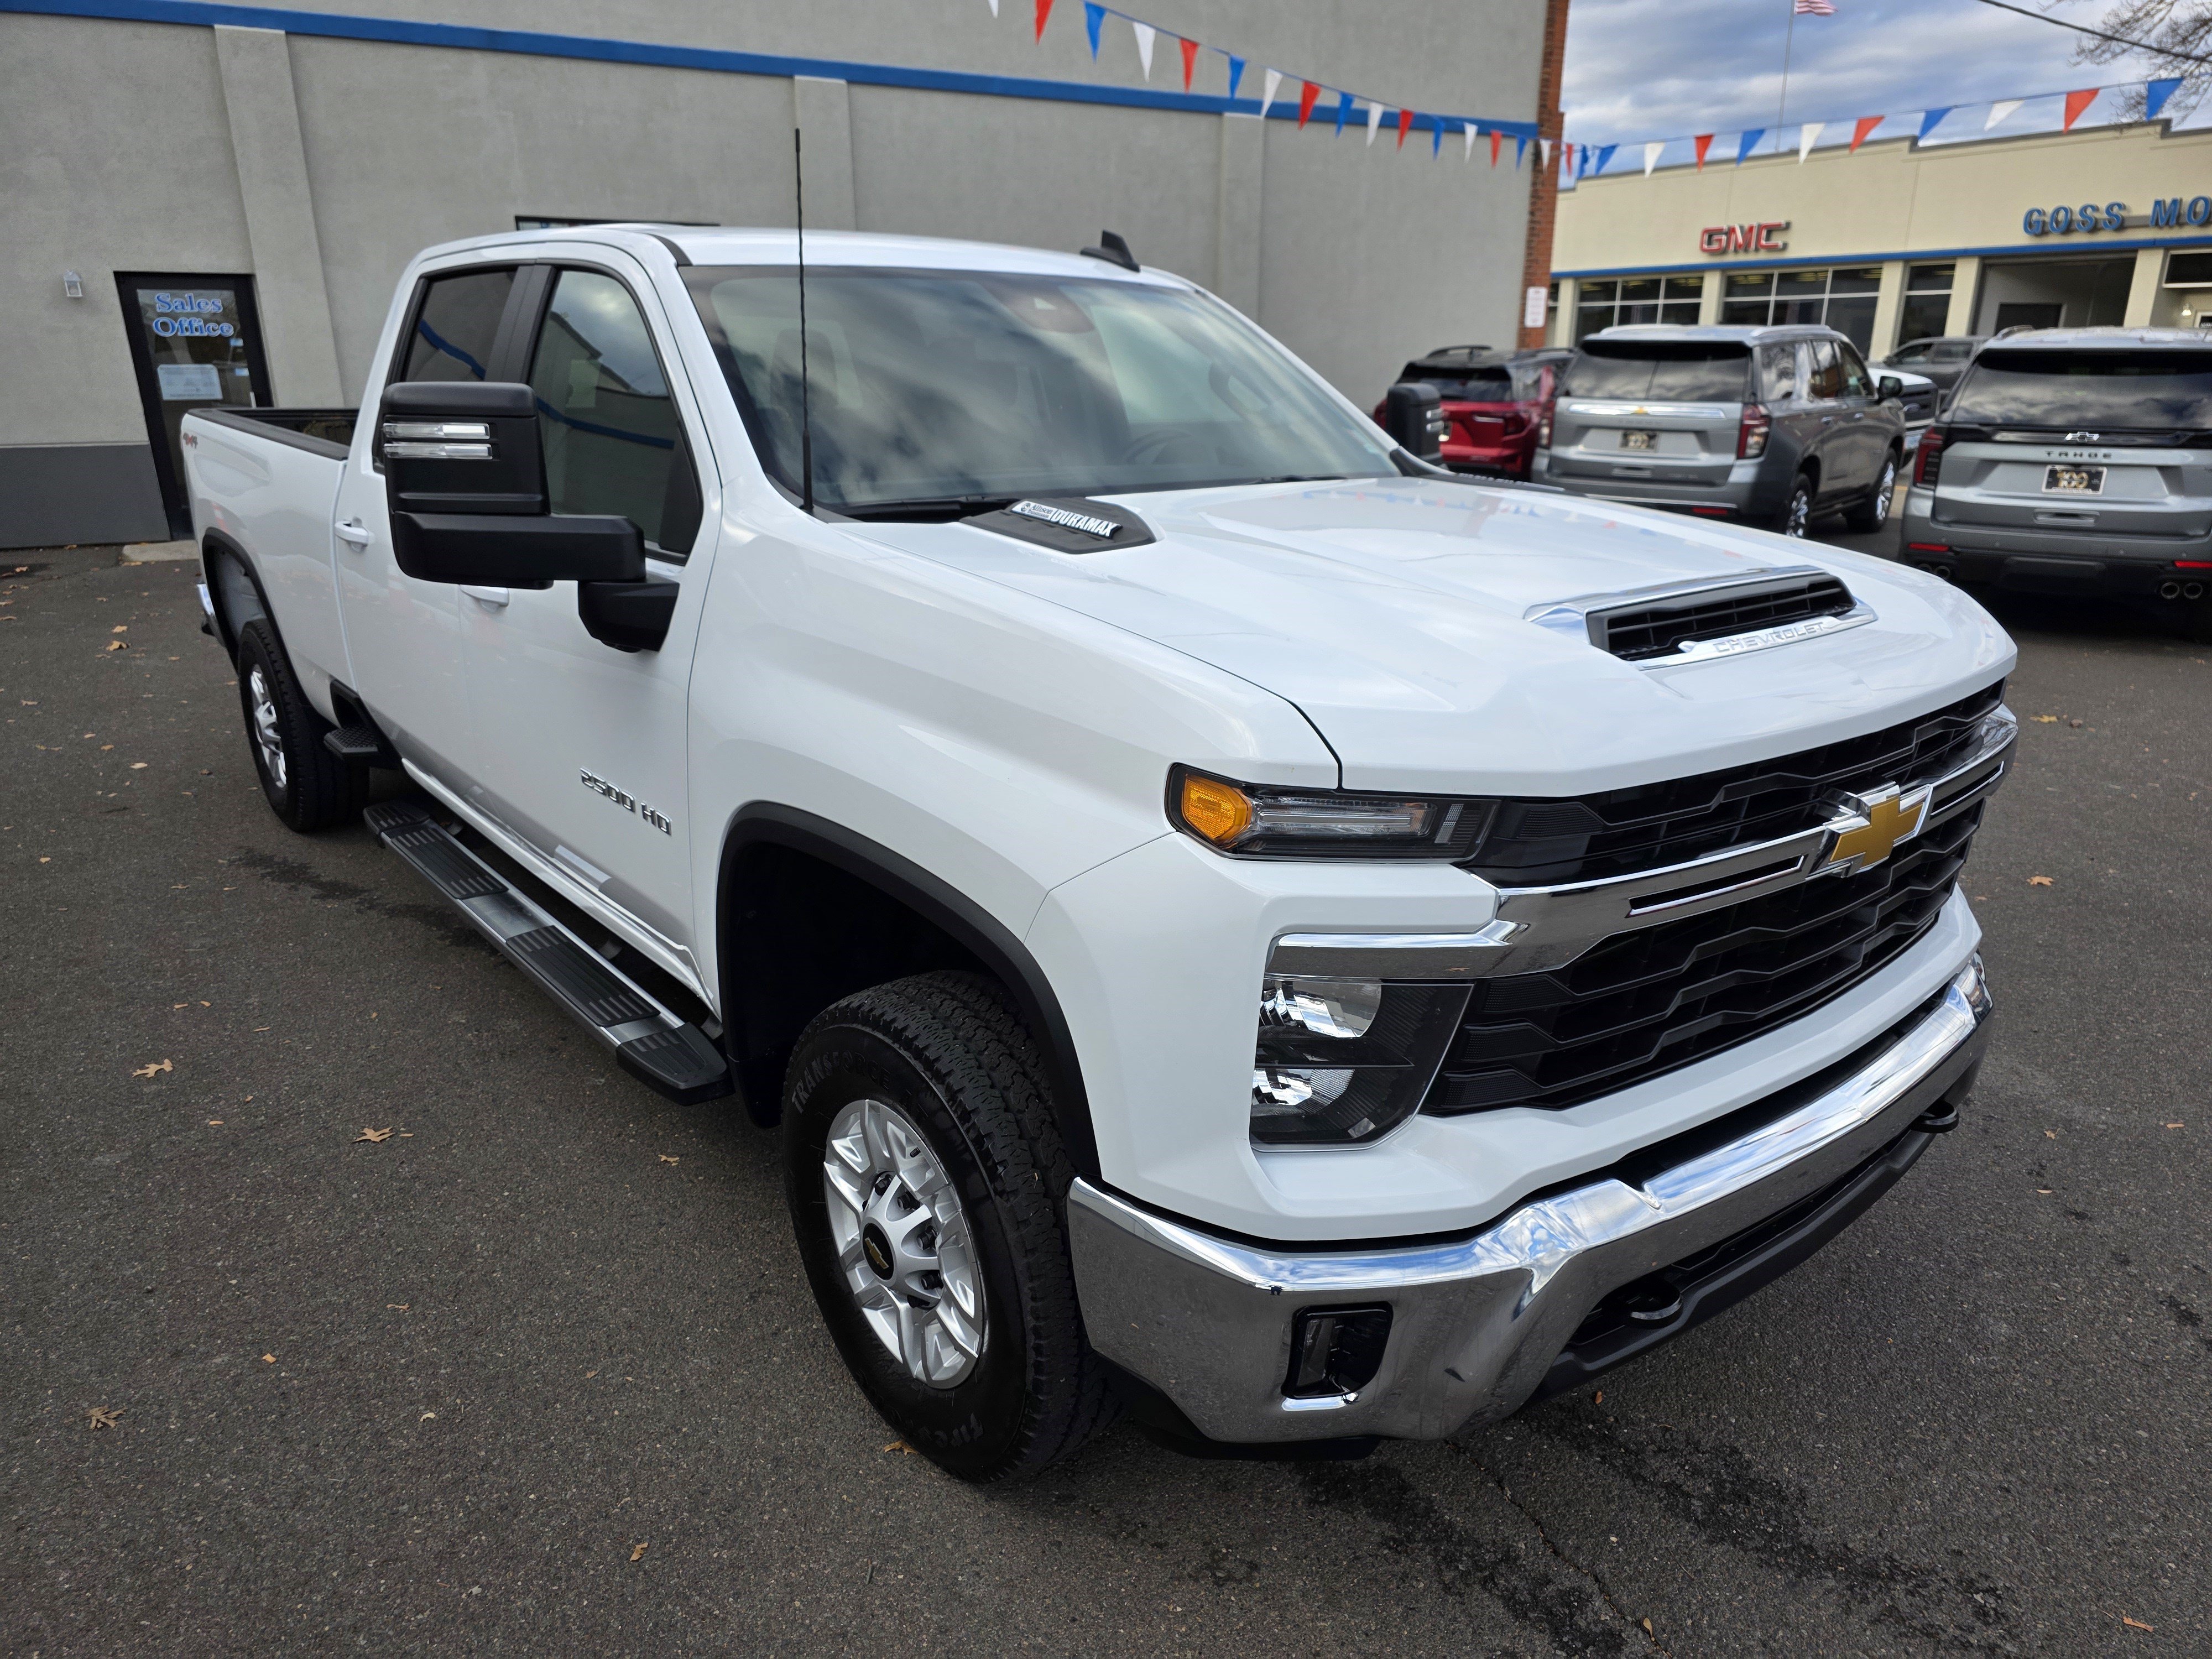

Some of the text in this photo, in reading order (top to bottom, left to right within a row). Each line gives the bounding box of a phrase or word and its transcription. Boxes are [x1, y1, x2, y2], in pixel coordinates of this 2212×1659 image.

[2023, 195, 2212, 236] GOSS MO
[1700, 221, 1792, 255] GMC
[154, 292, 223, 314] Sales
[153, 317, 234, 337] Office
[2045, 451, 2112, 460] TAHOE
[1050, 509, 1122, 538] DURAMAX
[1713, 622, 1823, 653] CHEVROLET
[579, 766, 673, 837] 2500 HD
[791, 1049, 890, 1115] TRANSFORCE
